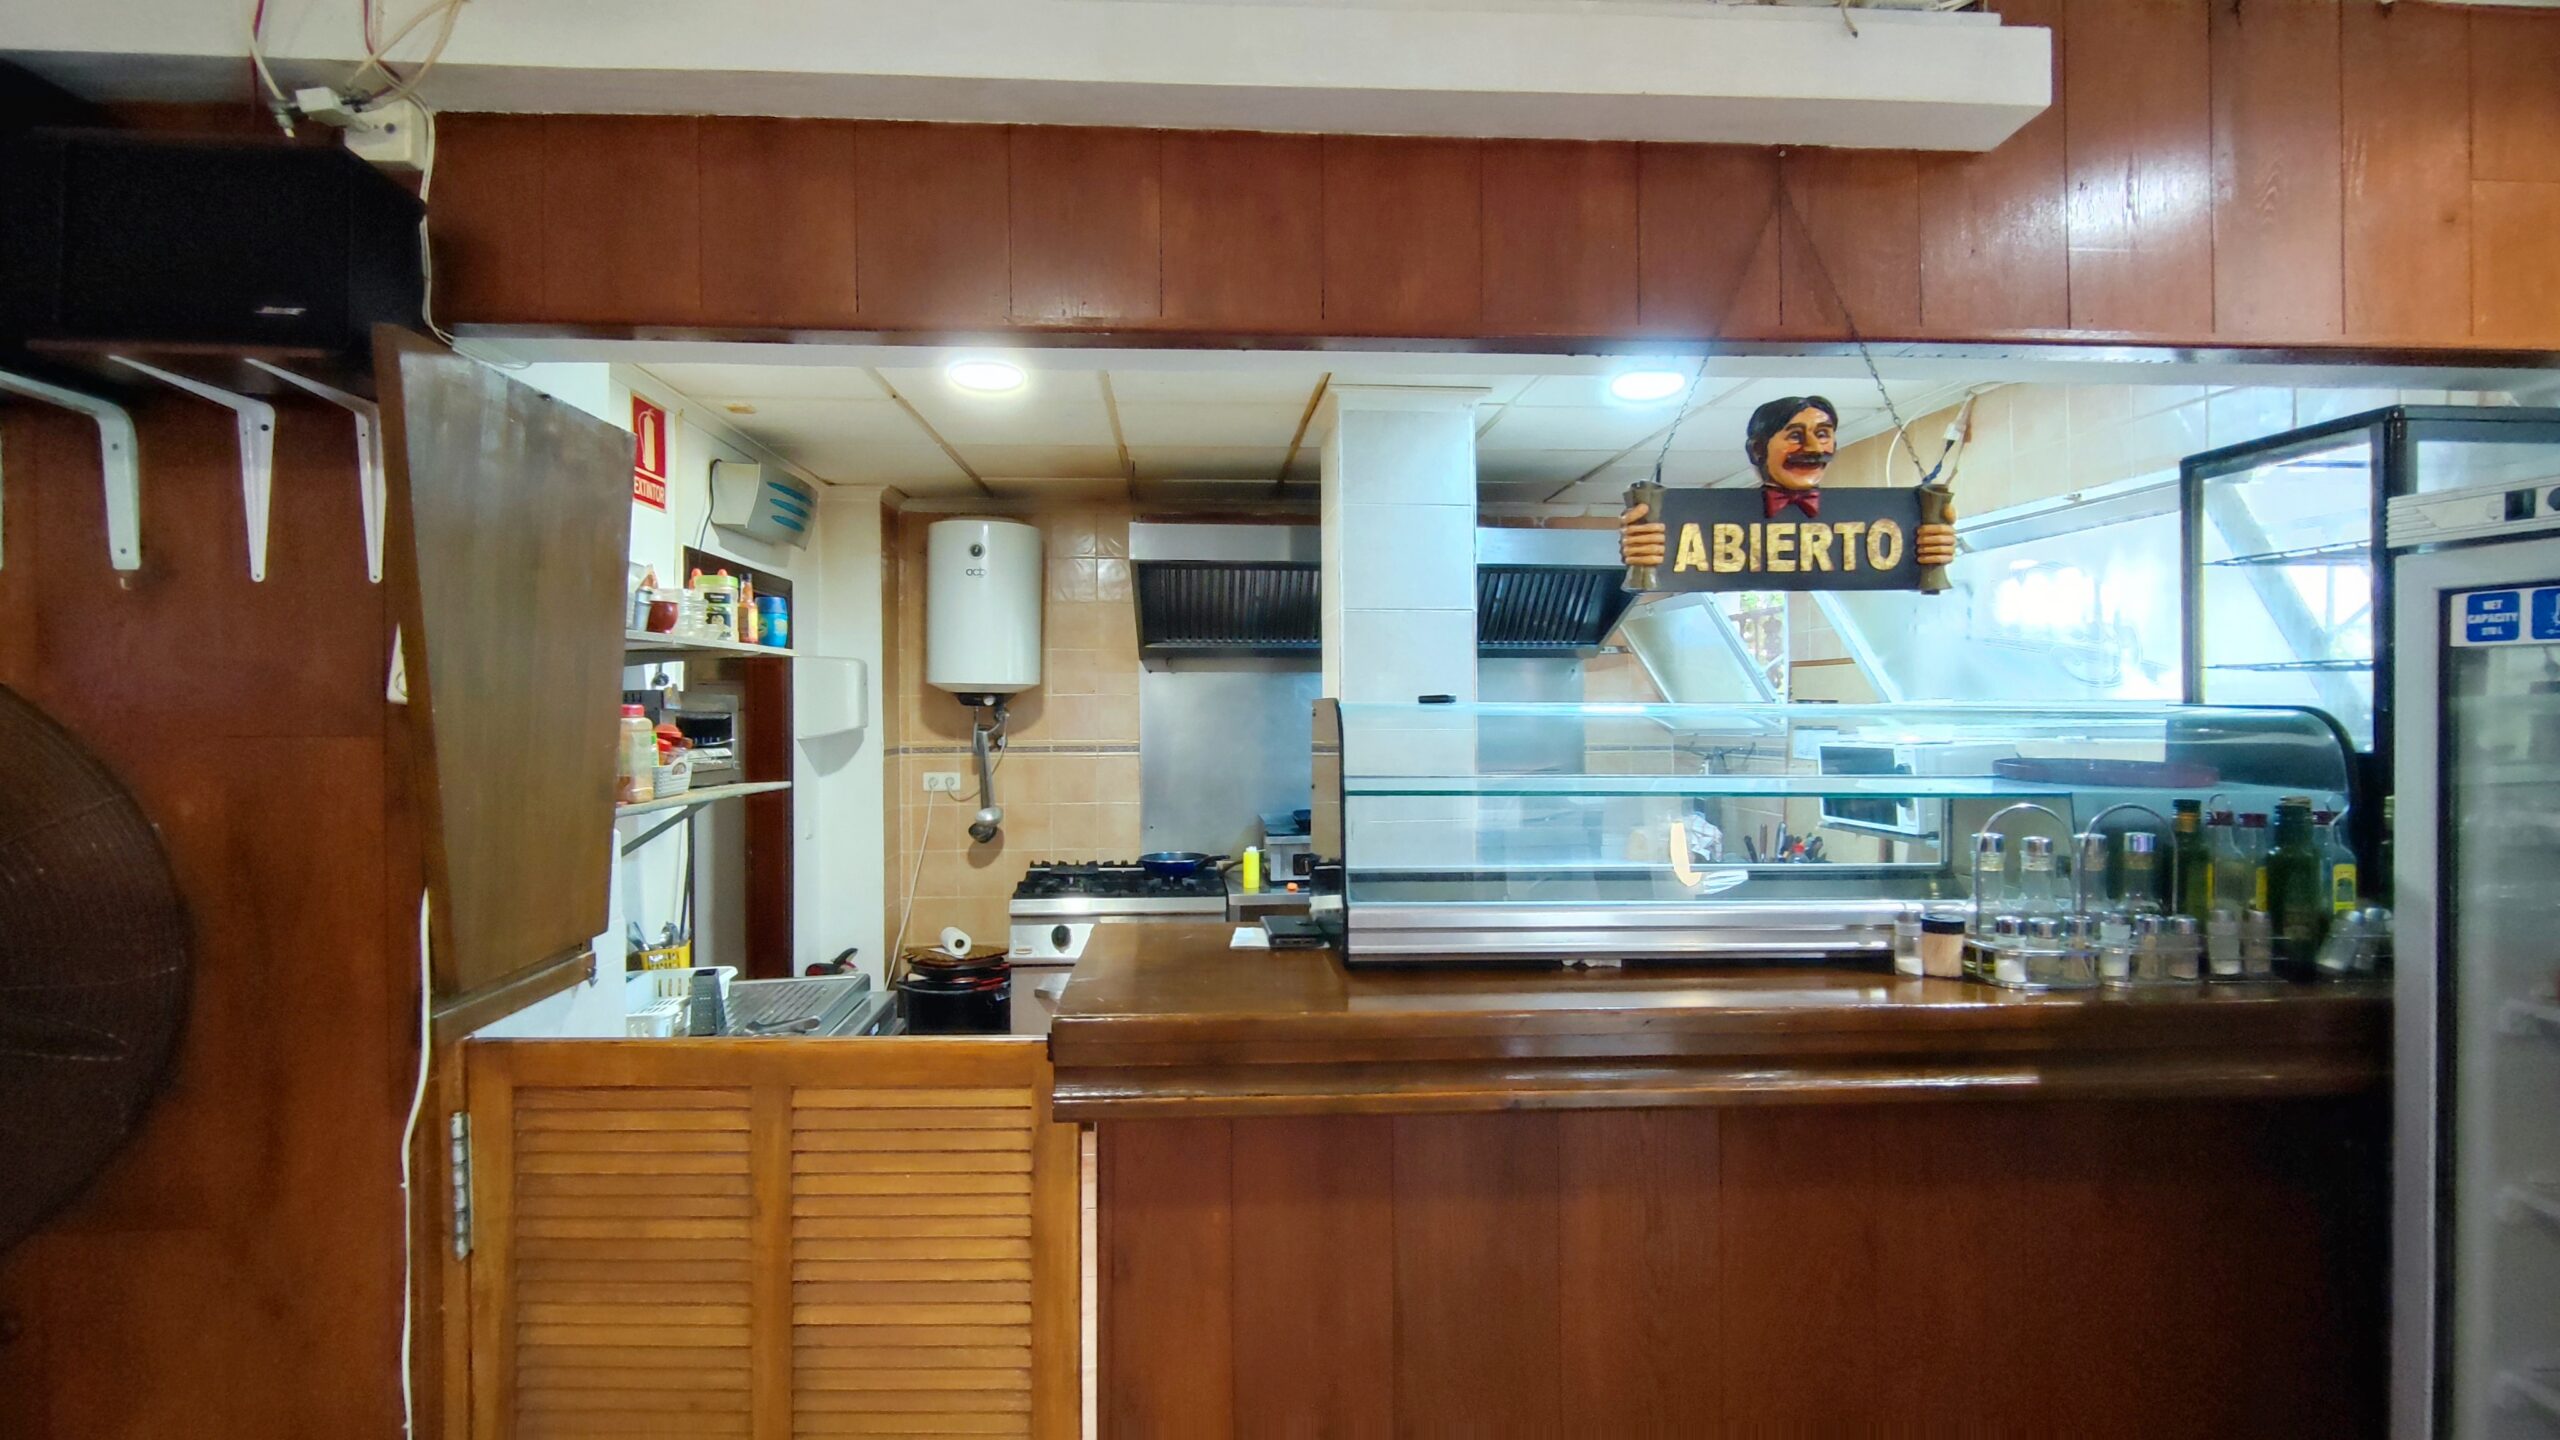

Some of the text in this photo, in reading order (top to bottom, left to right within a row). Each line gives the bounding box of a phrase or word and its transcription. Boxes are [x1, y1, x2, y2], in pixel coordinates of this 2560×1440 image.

[634, 476, 665, 504] EXTINTOR
[1673, 518, 1904, 573] ABIERTO
[2467, 612, 2519, 624] CAPACITY
